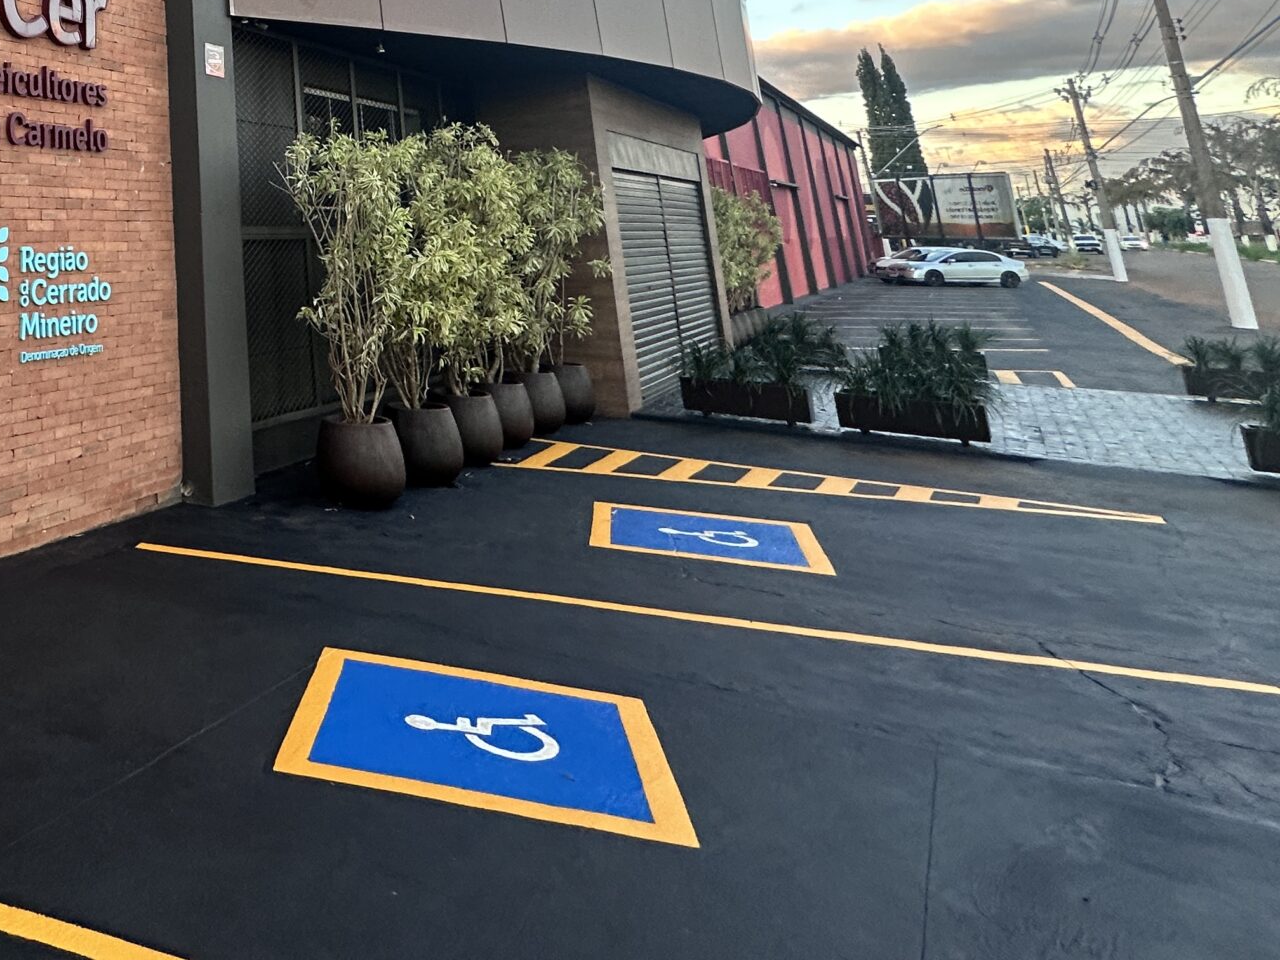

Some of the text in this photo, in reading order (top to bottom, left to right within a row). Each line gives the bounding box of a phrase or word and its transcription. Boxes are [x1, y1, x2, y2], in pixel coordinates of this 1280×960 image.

[6, 111, 109, 152] Carmelo
[20, 245, 89, 279] Região
[31, 276, 112, 306] Cerrado
[20, 309, 99, 341] Mineiro
